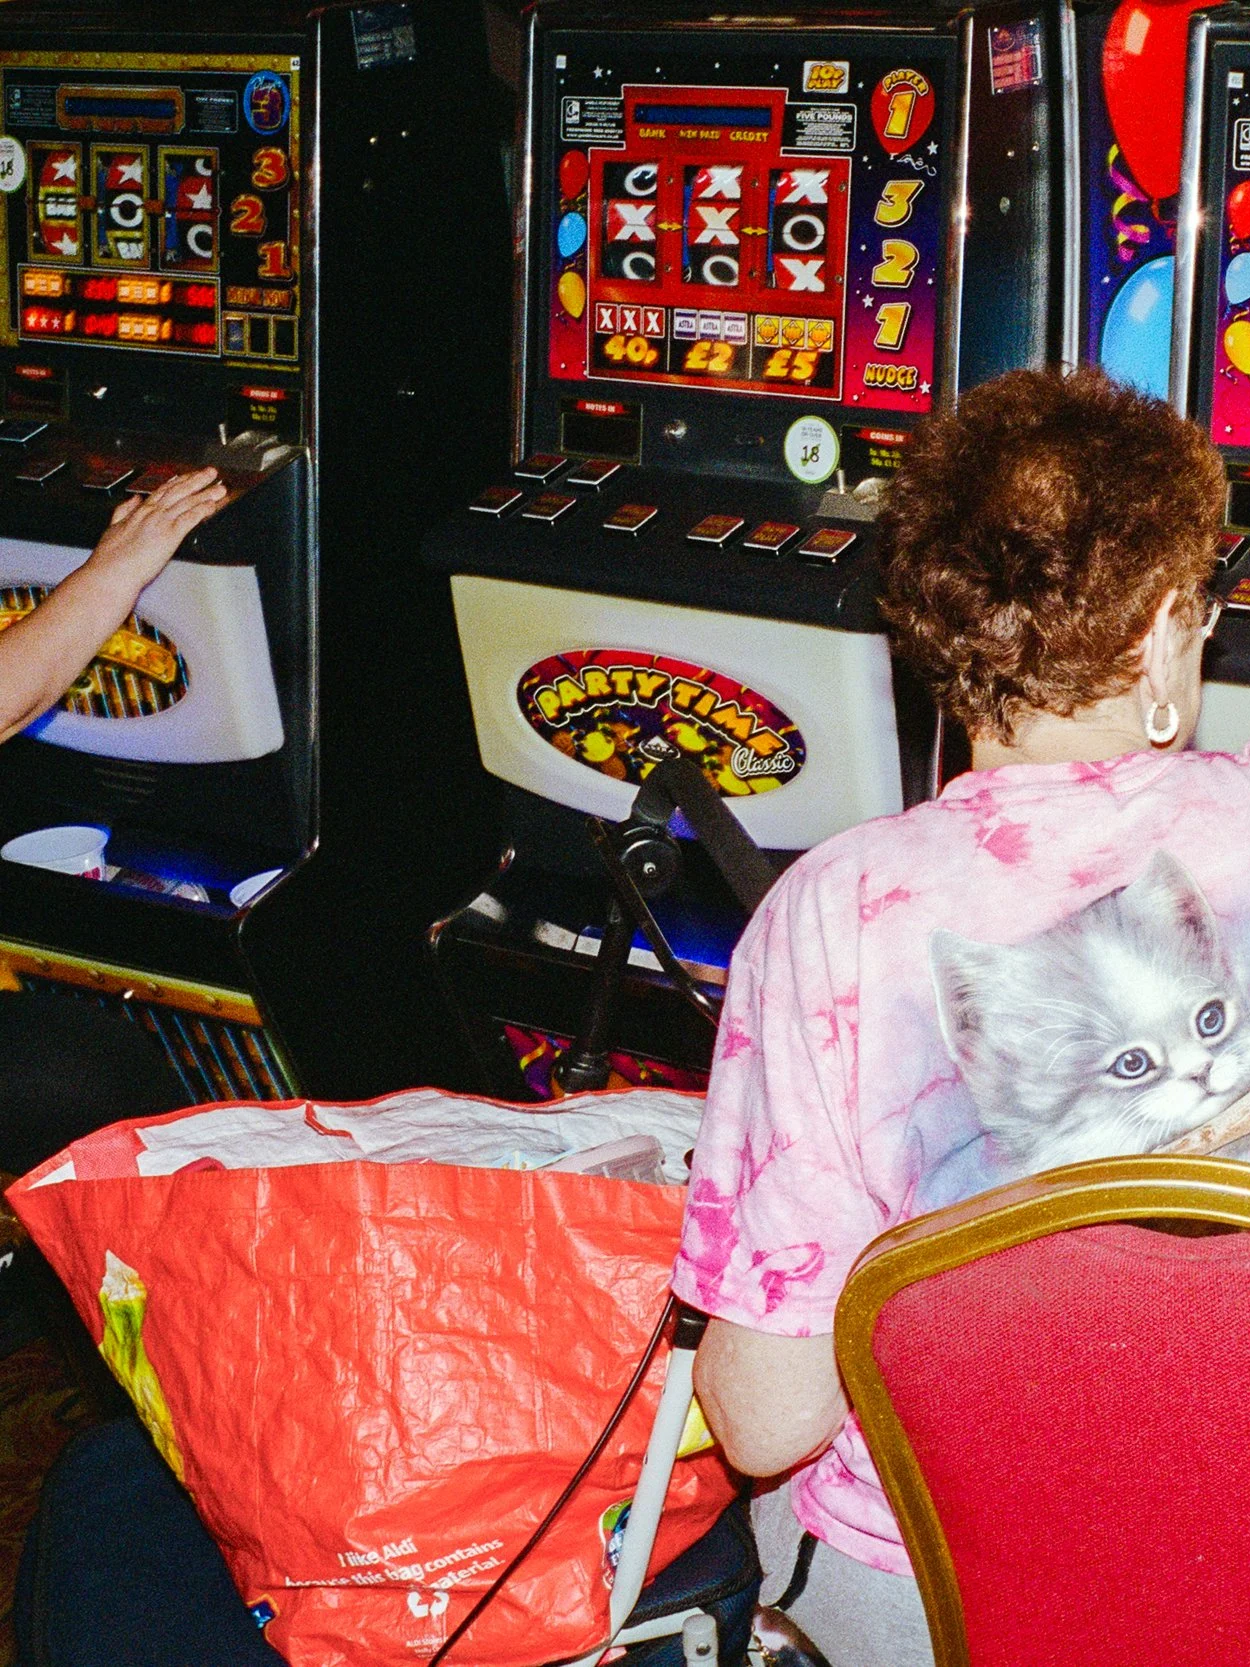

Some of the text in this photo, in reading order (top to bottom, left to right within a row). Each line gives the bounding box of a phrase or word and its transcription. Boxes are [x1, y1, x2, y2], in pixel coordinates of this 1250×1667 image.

[807, 78, 844, 90] PLAY
[883, 69, 929, 95] PLAYER
[796, 112, 852, 122] FIVE POUNDS
[884, 90, 916, 139] 1
[639, 128, 769, 142] BANK WIN PAID CREDIT
[252, 147, 287, 188] 3
[230, 194, 265, 234] 2
[874, 180, 925, 227] 3
[258, 241, 291, 278] 1
[872, 239, 919, 288] 2
[874, 302, 911, 350] 1
[604, 335, 657, 364] 40p
[684, 341, 733, 372] £2
[765, 349, 819, 380] £5
[863, 363, 917, 390] NUDGE
[585, 403, 606, 412] NOTES
[870, 431, 894, 440] COINS
[802, 445, 819, 462] 18
[535, 667, 788, 756] PARTY TIME
[733, 748, 794, 777] Classic
[347, 1551, 380, 1567] like
[382, 1537, 418, 1561] Aldi
[351, 1571, 386, 1585] this
[385, 1563, 425, 1582] bag
[424, 1539, 504, 1573] contains
